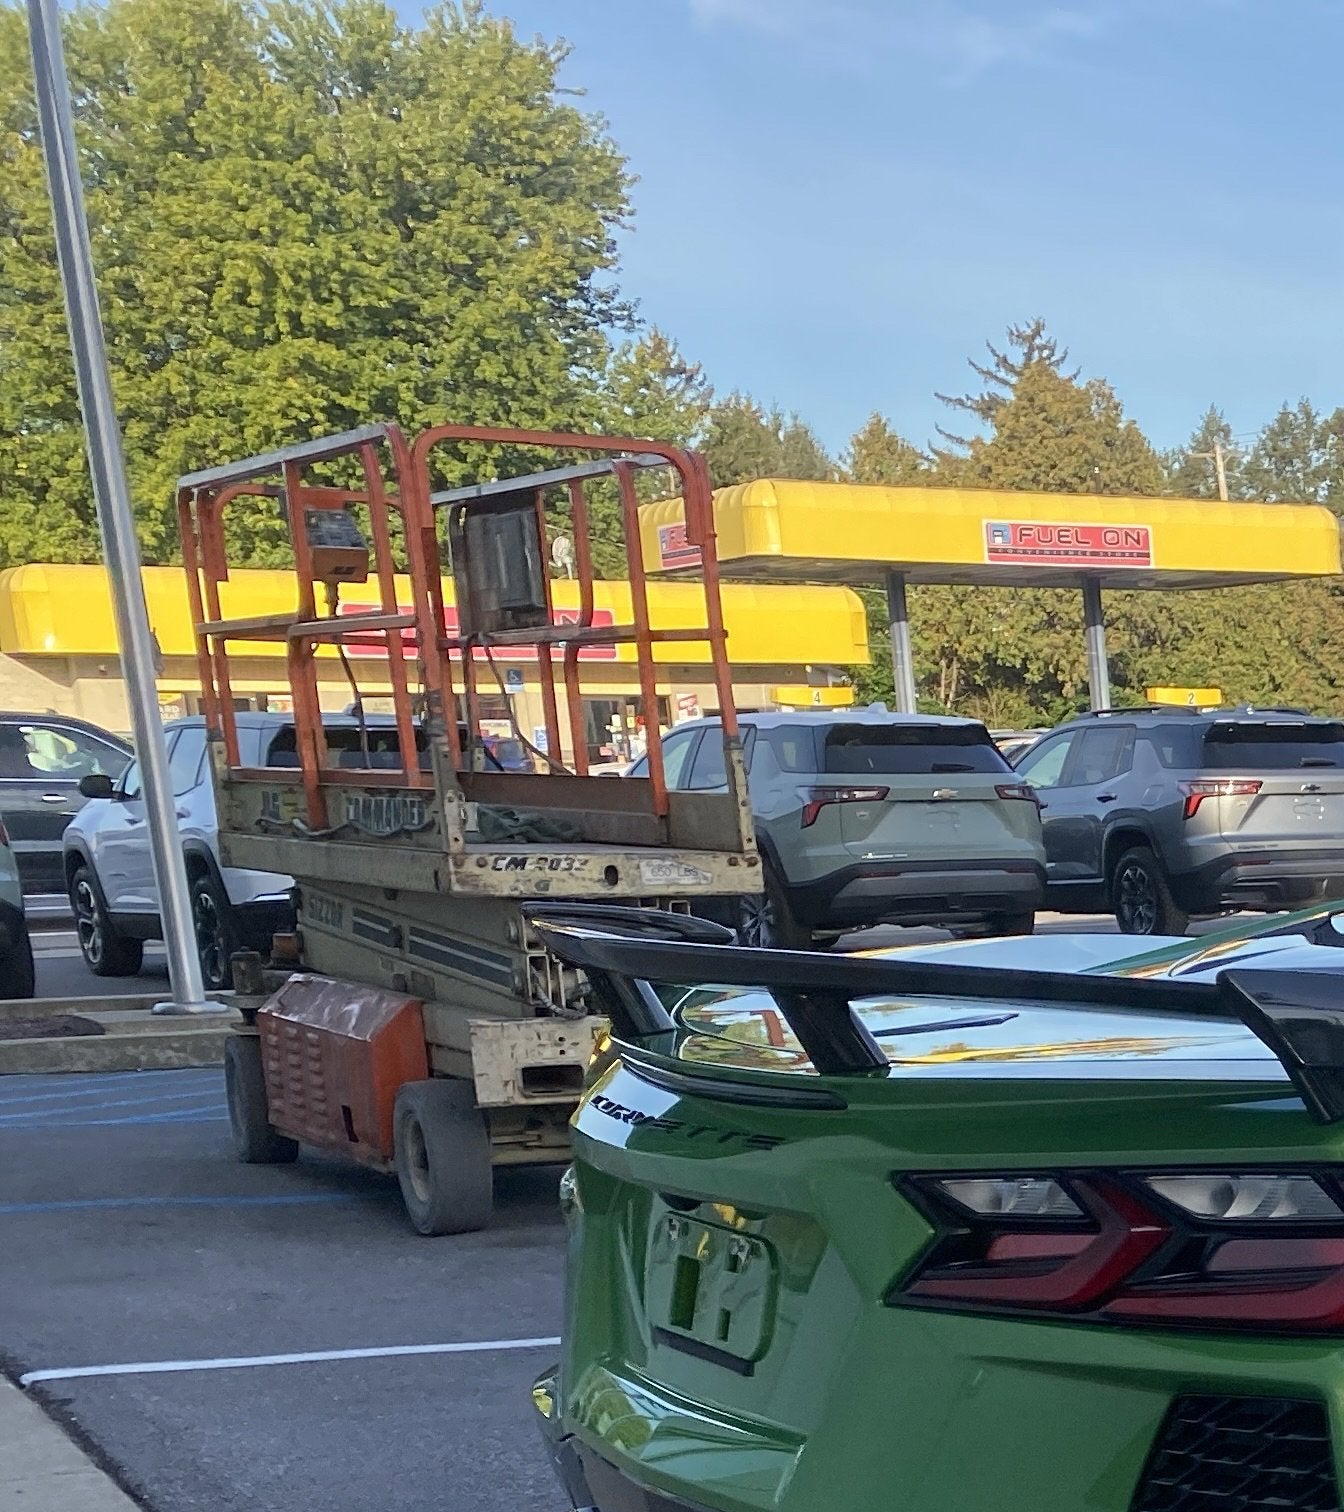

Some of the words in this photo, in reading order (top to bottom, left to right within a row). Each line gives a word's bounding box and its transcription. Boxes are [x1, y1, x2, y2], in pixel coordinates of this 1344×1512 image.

[1017, 526, 1091, 545] FUEL
[1103, 529, 1142, 547] ON
[814, 691, 821, 704] 4
[1188, 692, 1195, 705] 2
